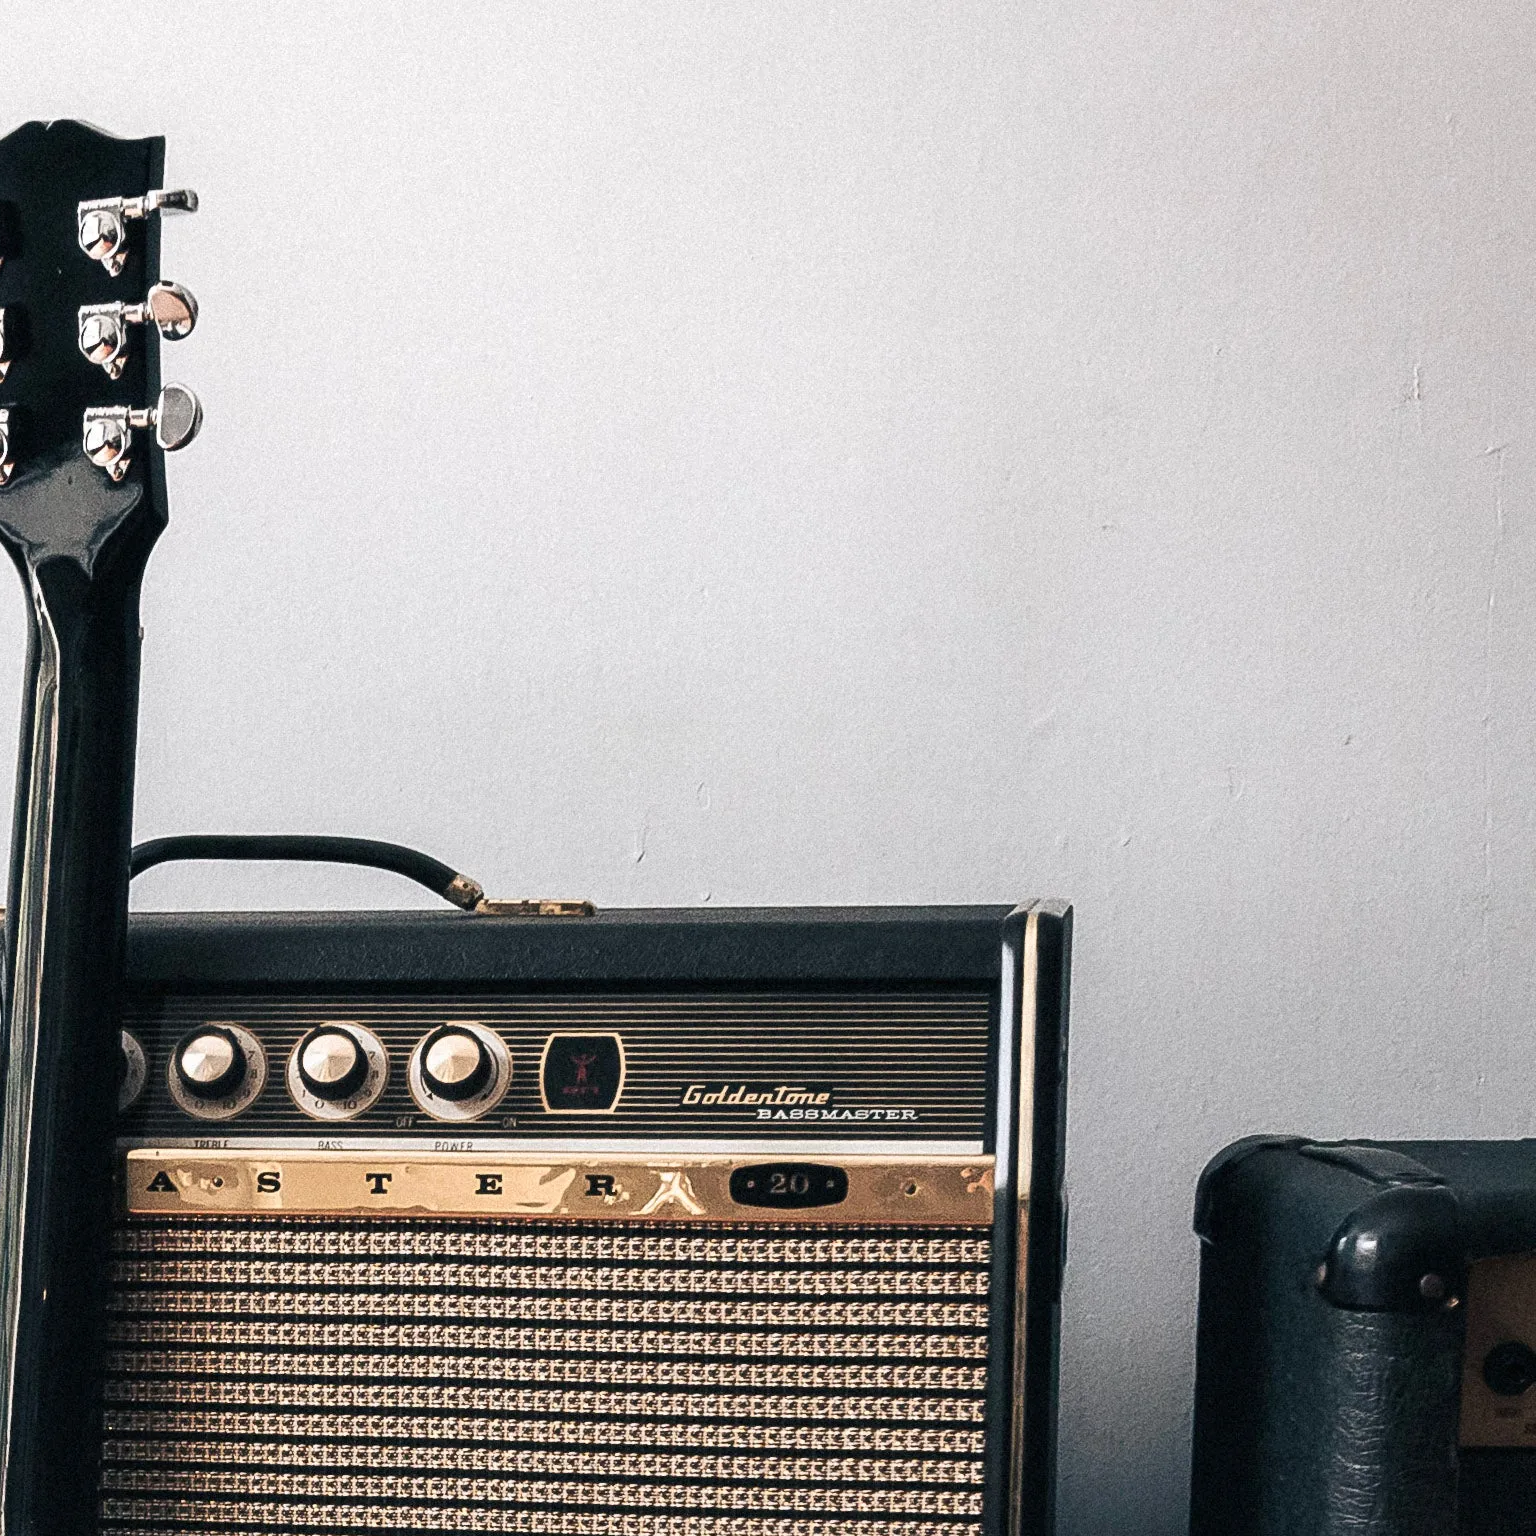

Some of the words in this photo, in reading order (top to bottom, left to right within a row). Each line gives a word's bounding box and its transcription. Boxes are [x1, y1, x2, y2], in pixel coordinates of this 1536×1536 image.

[756, 1108, 918, 1121] BASSMASTER
[434, 1141, 473, 1151] POWER
[769, 1172, 809, 1195] 20
